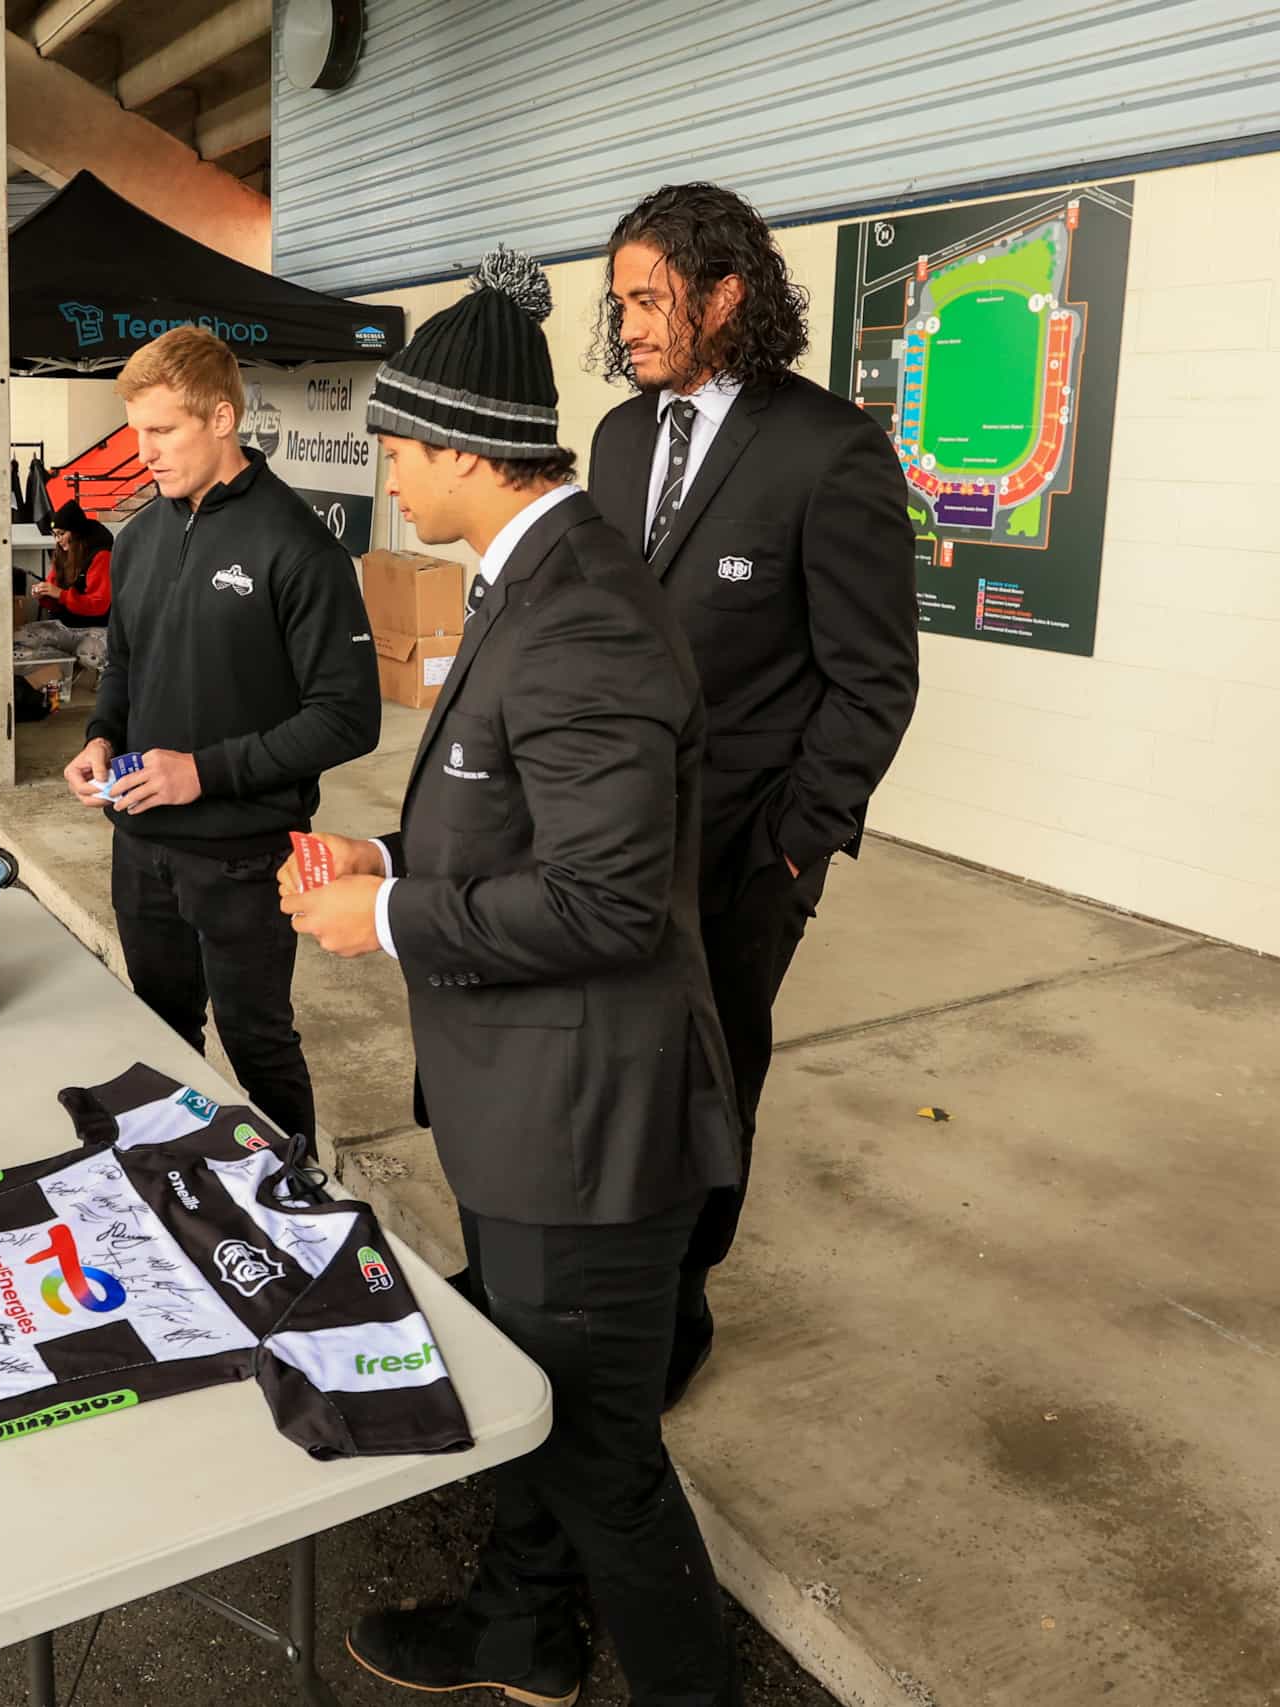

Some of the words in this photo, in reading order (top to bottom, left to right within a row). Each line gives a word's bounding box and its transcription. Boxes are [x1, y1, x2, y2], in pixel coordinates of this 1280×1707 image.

[306, 378, 353, 412] Official
[238, 411, 282, 434] AGPIES
[286, 430, 369, 467] Merchandise
